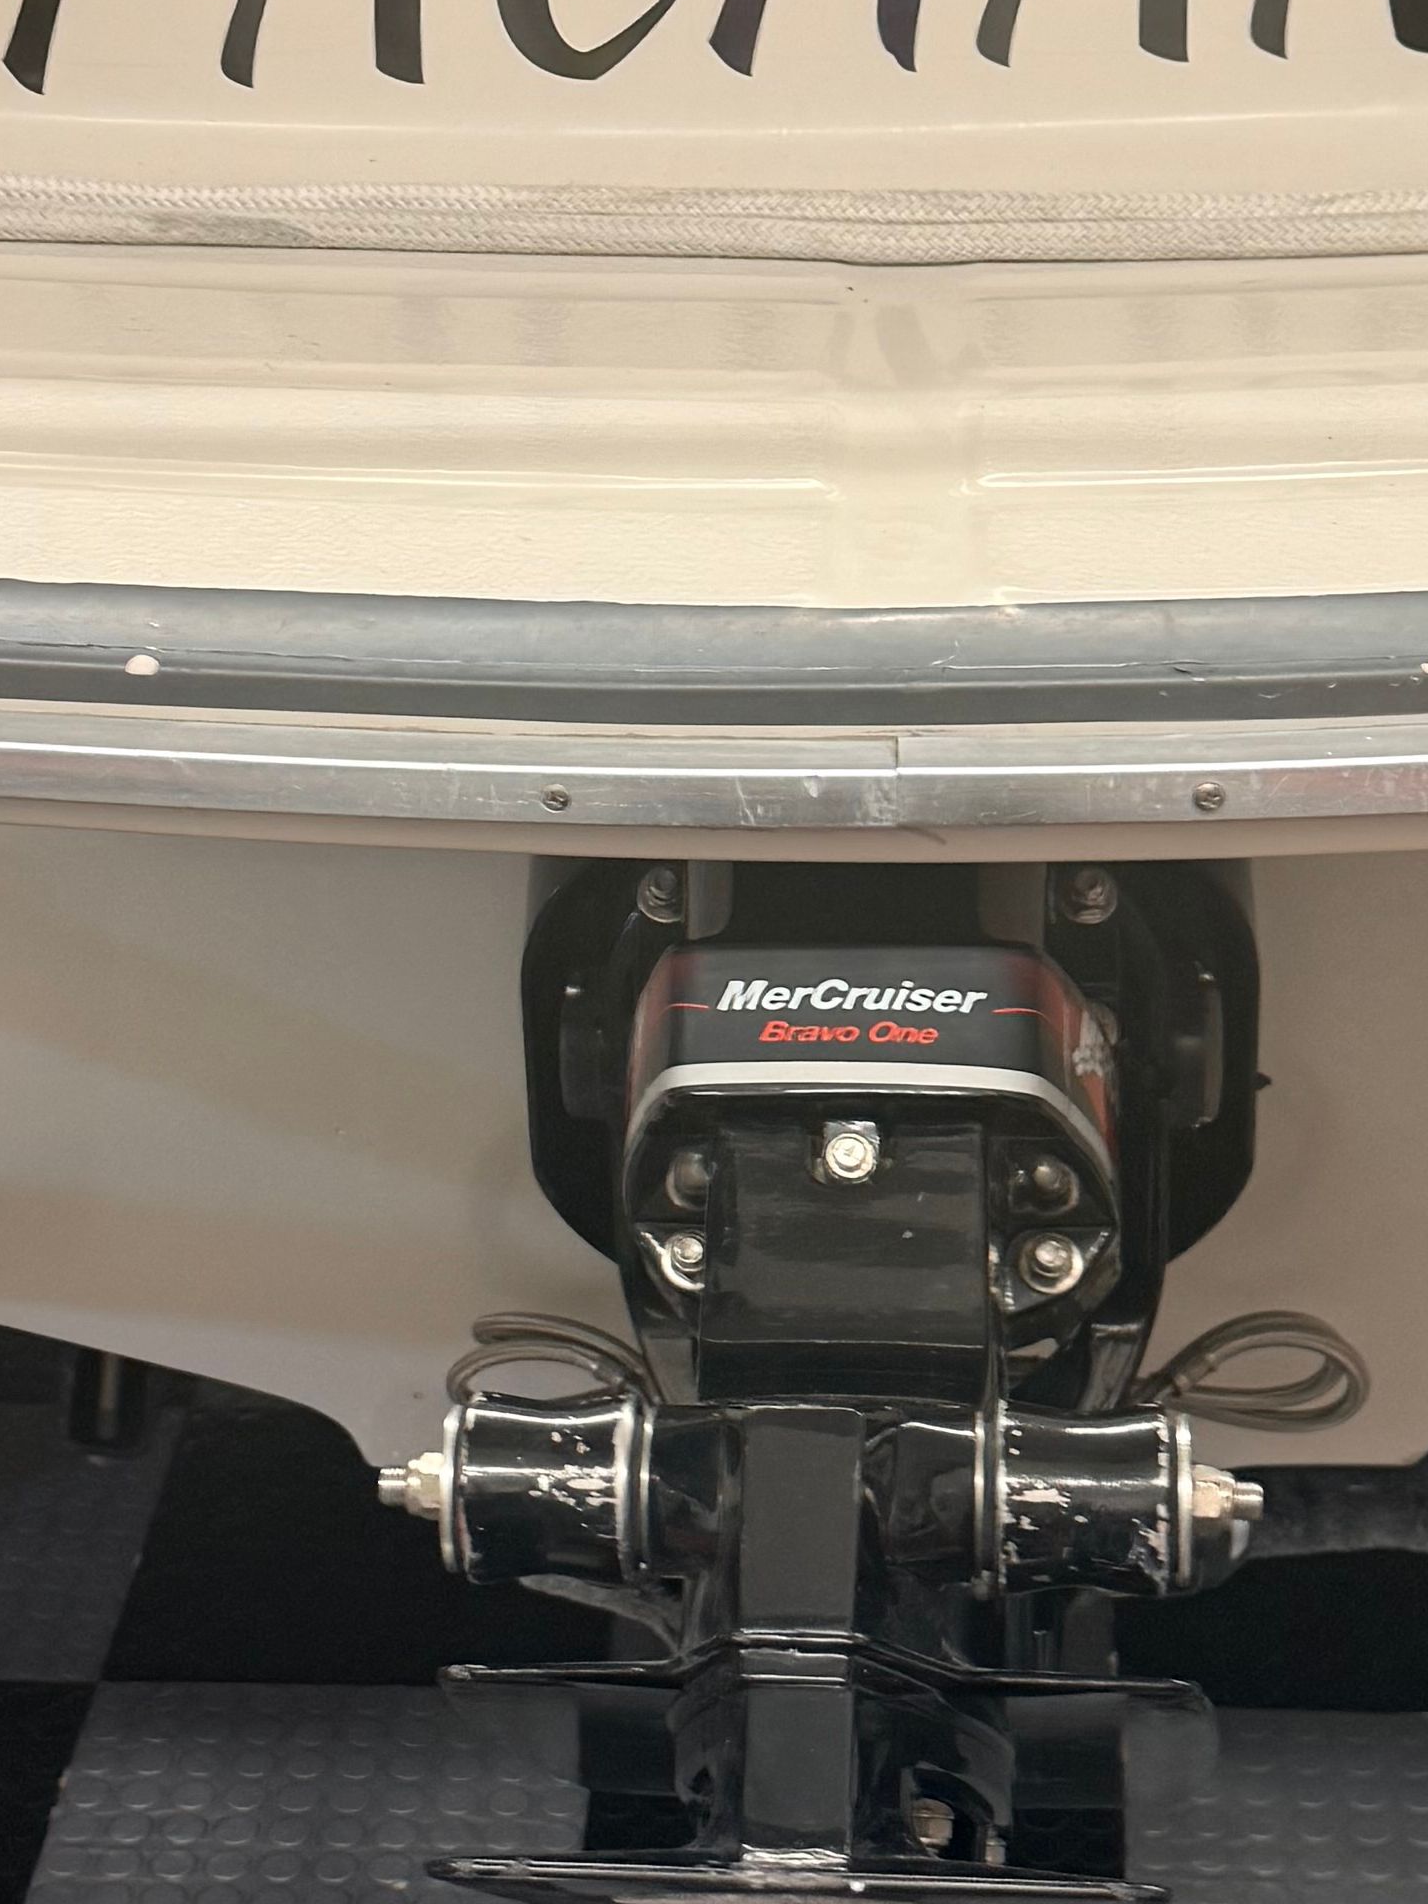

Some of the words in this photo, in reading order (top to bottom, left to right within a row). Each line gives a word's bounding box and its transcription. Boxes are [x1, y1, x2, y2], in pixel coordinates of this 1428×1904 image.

[716, 978, 989, 1014] MerCruiser
[758, 1020, 861, 1044] Bravo
[867, 1020, 940, 1045] One
